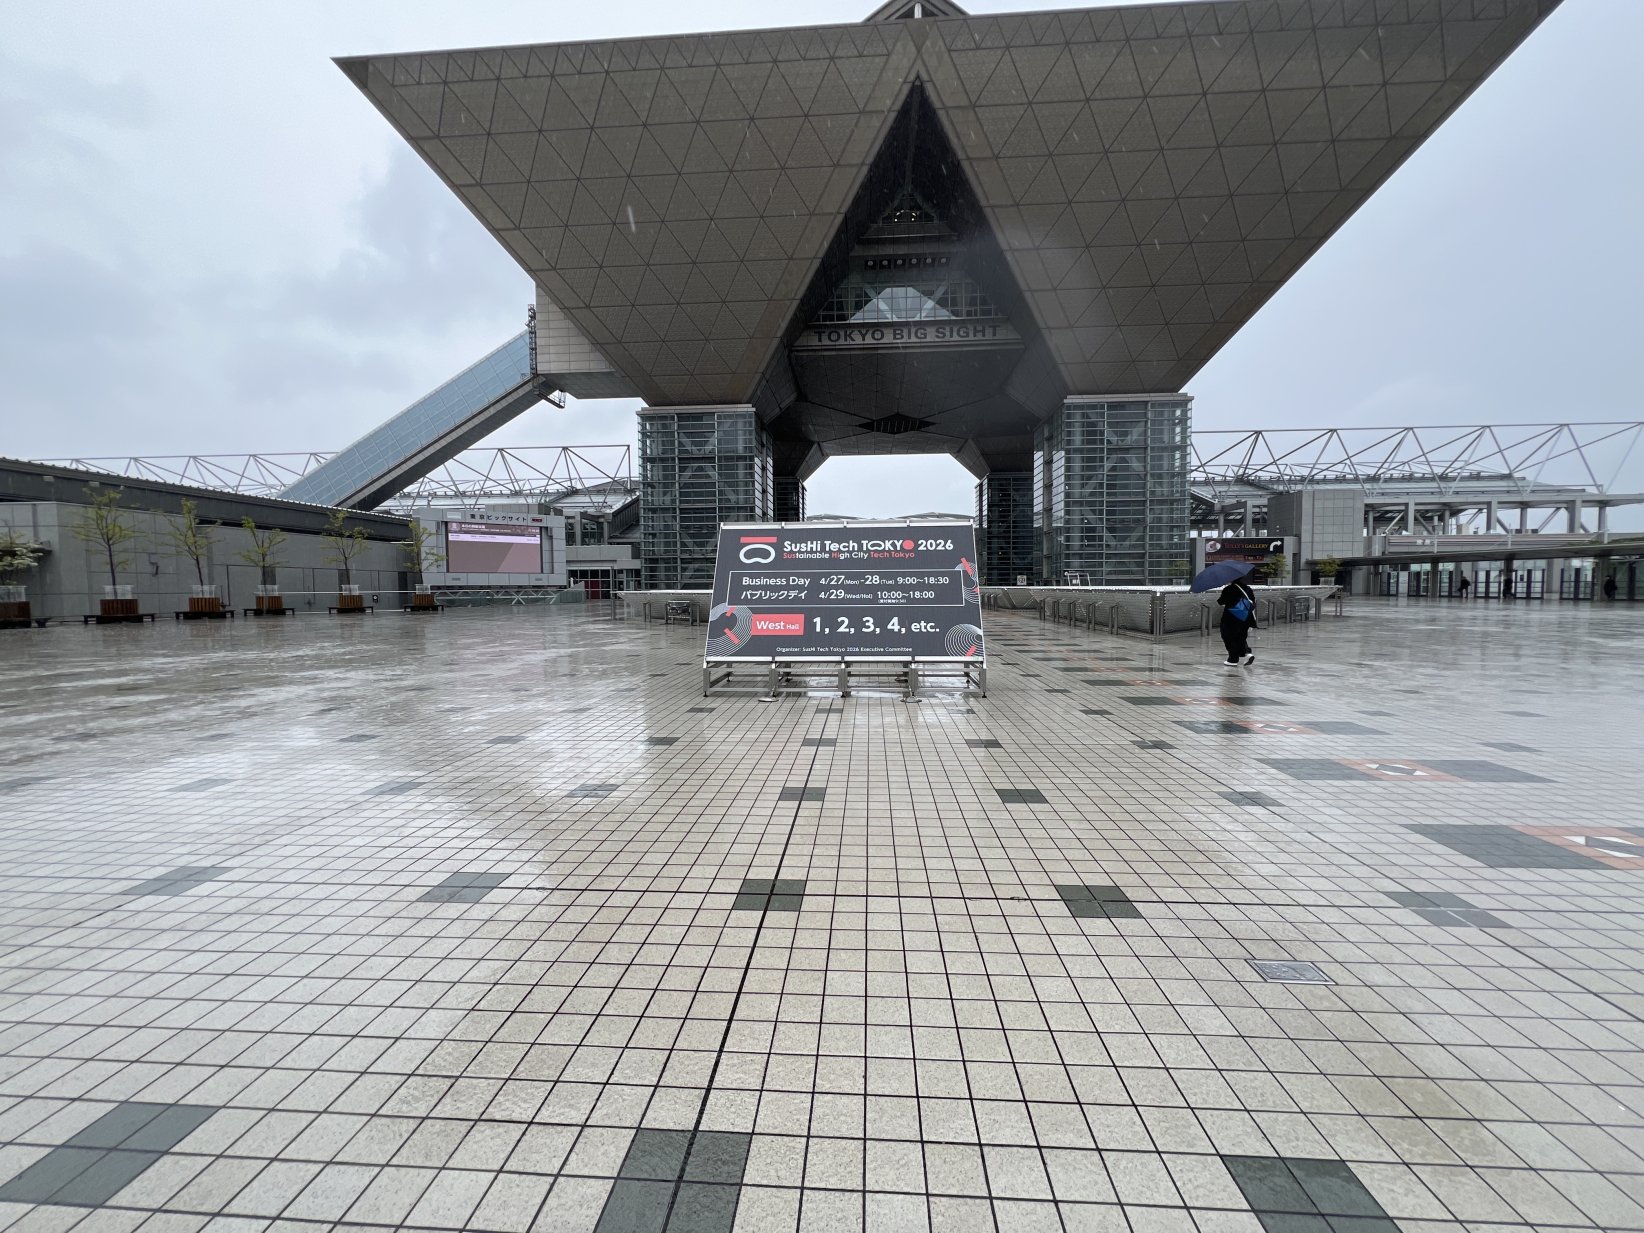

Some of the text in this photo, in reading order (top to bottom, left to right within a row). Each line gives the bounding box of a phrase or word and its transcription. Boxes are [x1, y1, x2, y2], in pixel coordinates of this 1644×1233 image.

[814, 325, 1001, 343] TOKYO BIG SIGHT
[470, 513, 527, 523] 東京ビッグサイト
[783, 540, 821, 552] SusHi
[824, 540, 858, 551] Tech
[918, 539, 954, 551] 2026
[832, 552, 850, 560] High
[852, 551, 869, 560] City
[891, 551, 915, 559] Tokyo
[742, 576, 787, 585] Business
[789, 576, 811, 587] Day
[741, 590, 808, 599] パブリックデイ
[756, 620, 785, 630] West
[813, 616, 830, 635] 1,
[836, 616, 855, 635] 2,
[861, 616, 881, 635] 3,
[887, 616, 906, 634] 4,
[910, 620, 940, 633] etc.
